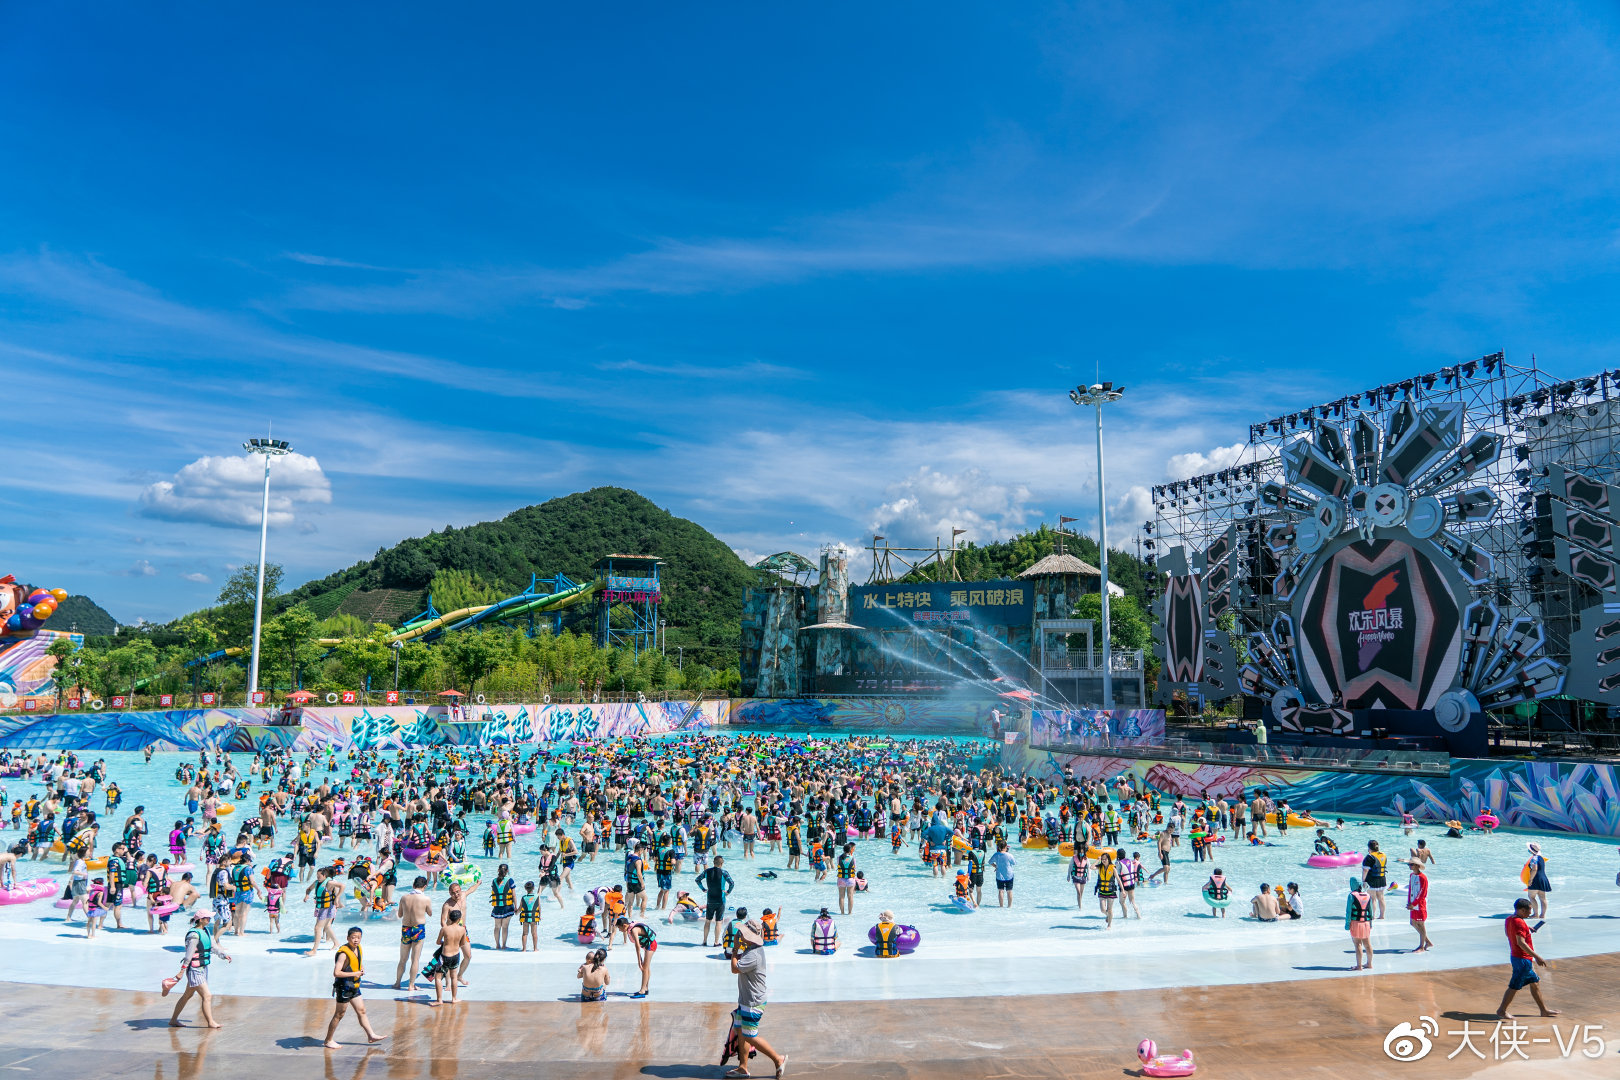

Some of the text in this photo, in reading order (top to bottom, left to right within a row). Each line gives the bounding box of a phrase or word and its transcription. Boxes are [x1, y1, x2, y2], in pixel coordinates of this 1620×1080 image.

[601, 590, 662, 604] 开心麻花
[863, 588, 1024, 609] 水上特快 乘风破浪
[1348, 607, 1403, 631] 欢乐风暴
